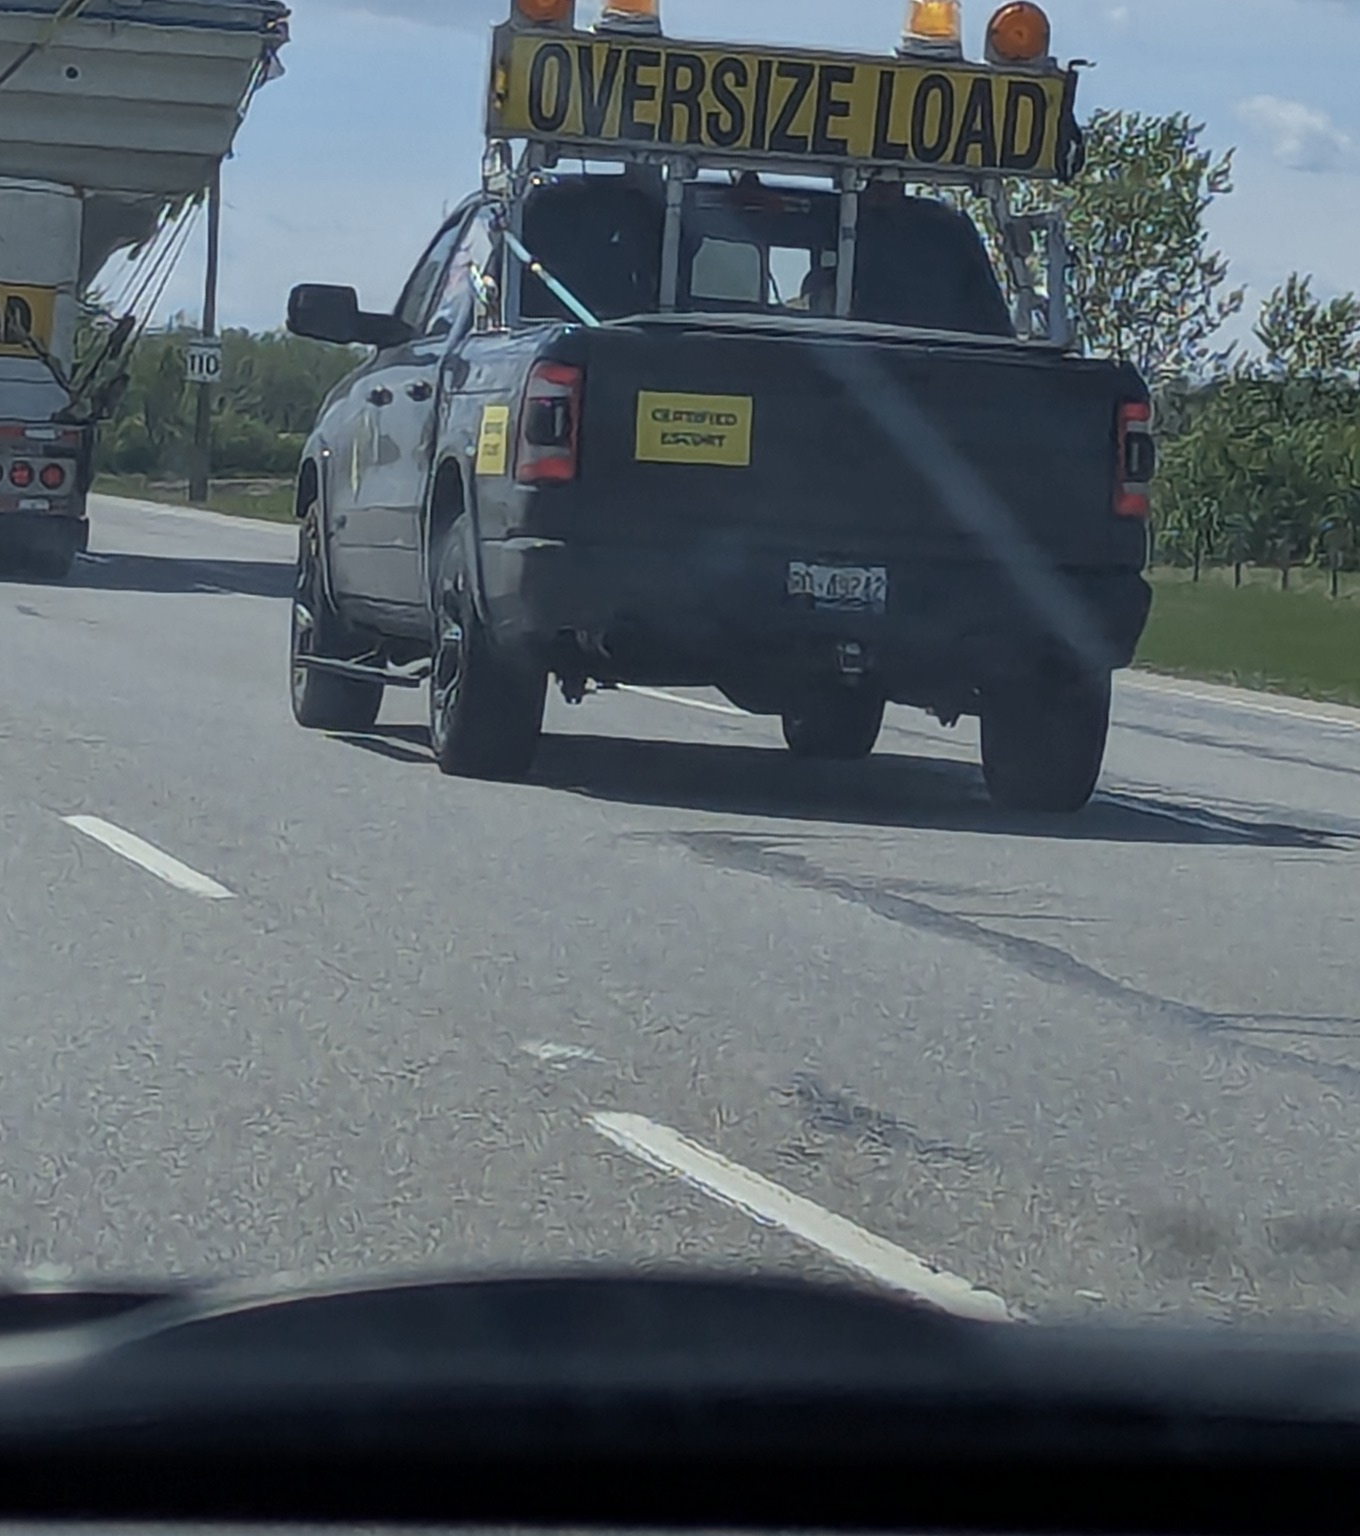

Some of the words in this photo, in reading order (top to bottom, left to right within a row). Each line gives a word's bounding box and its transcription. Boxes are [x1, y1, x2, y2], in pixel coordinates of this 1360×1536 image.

[527, 41, 854, 154] OVERSIZE
[871, 69, 1049, 169] LOAD
[190, 354, 219, 376] 110
